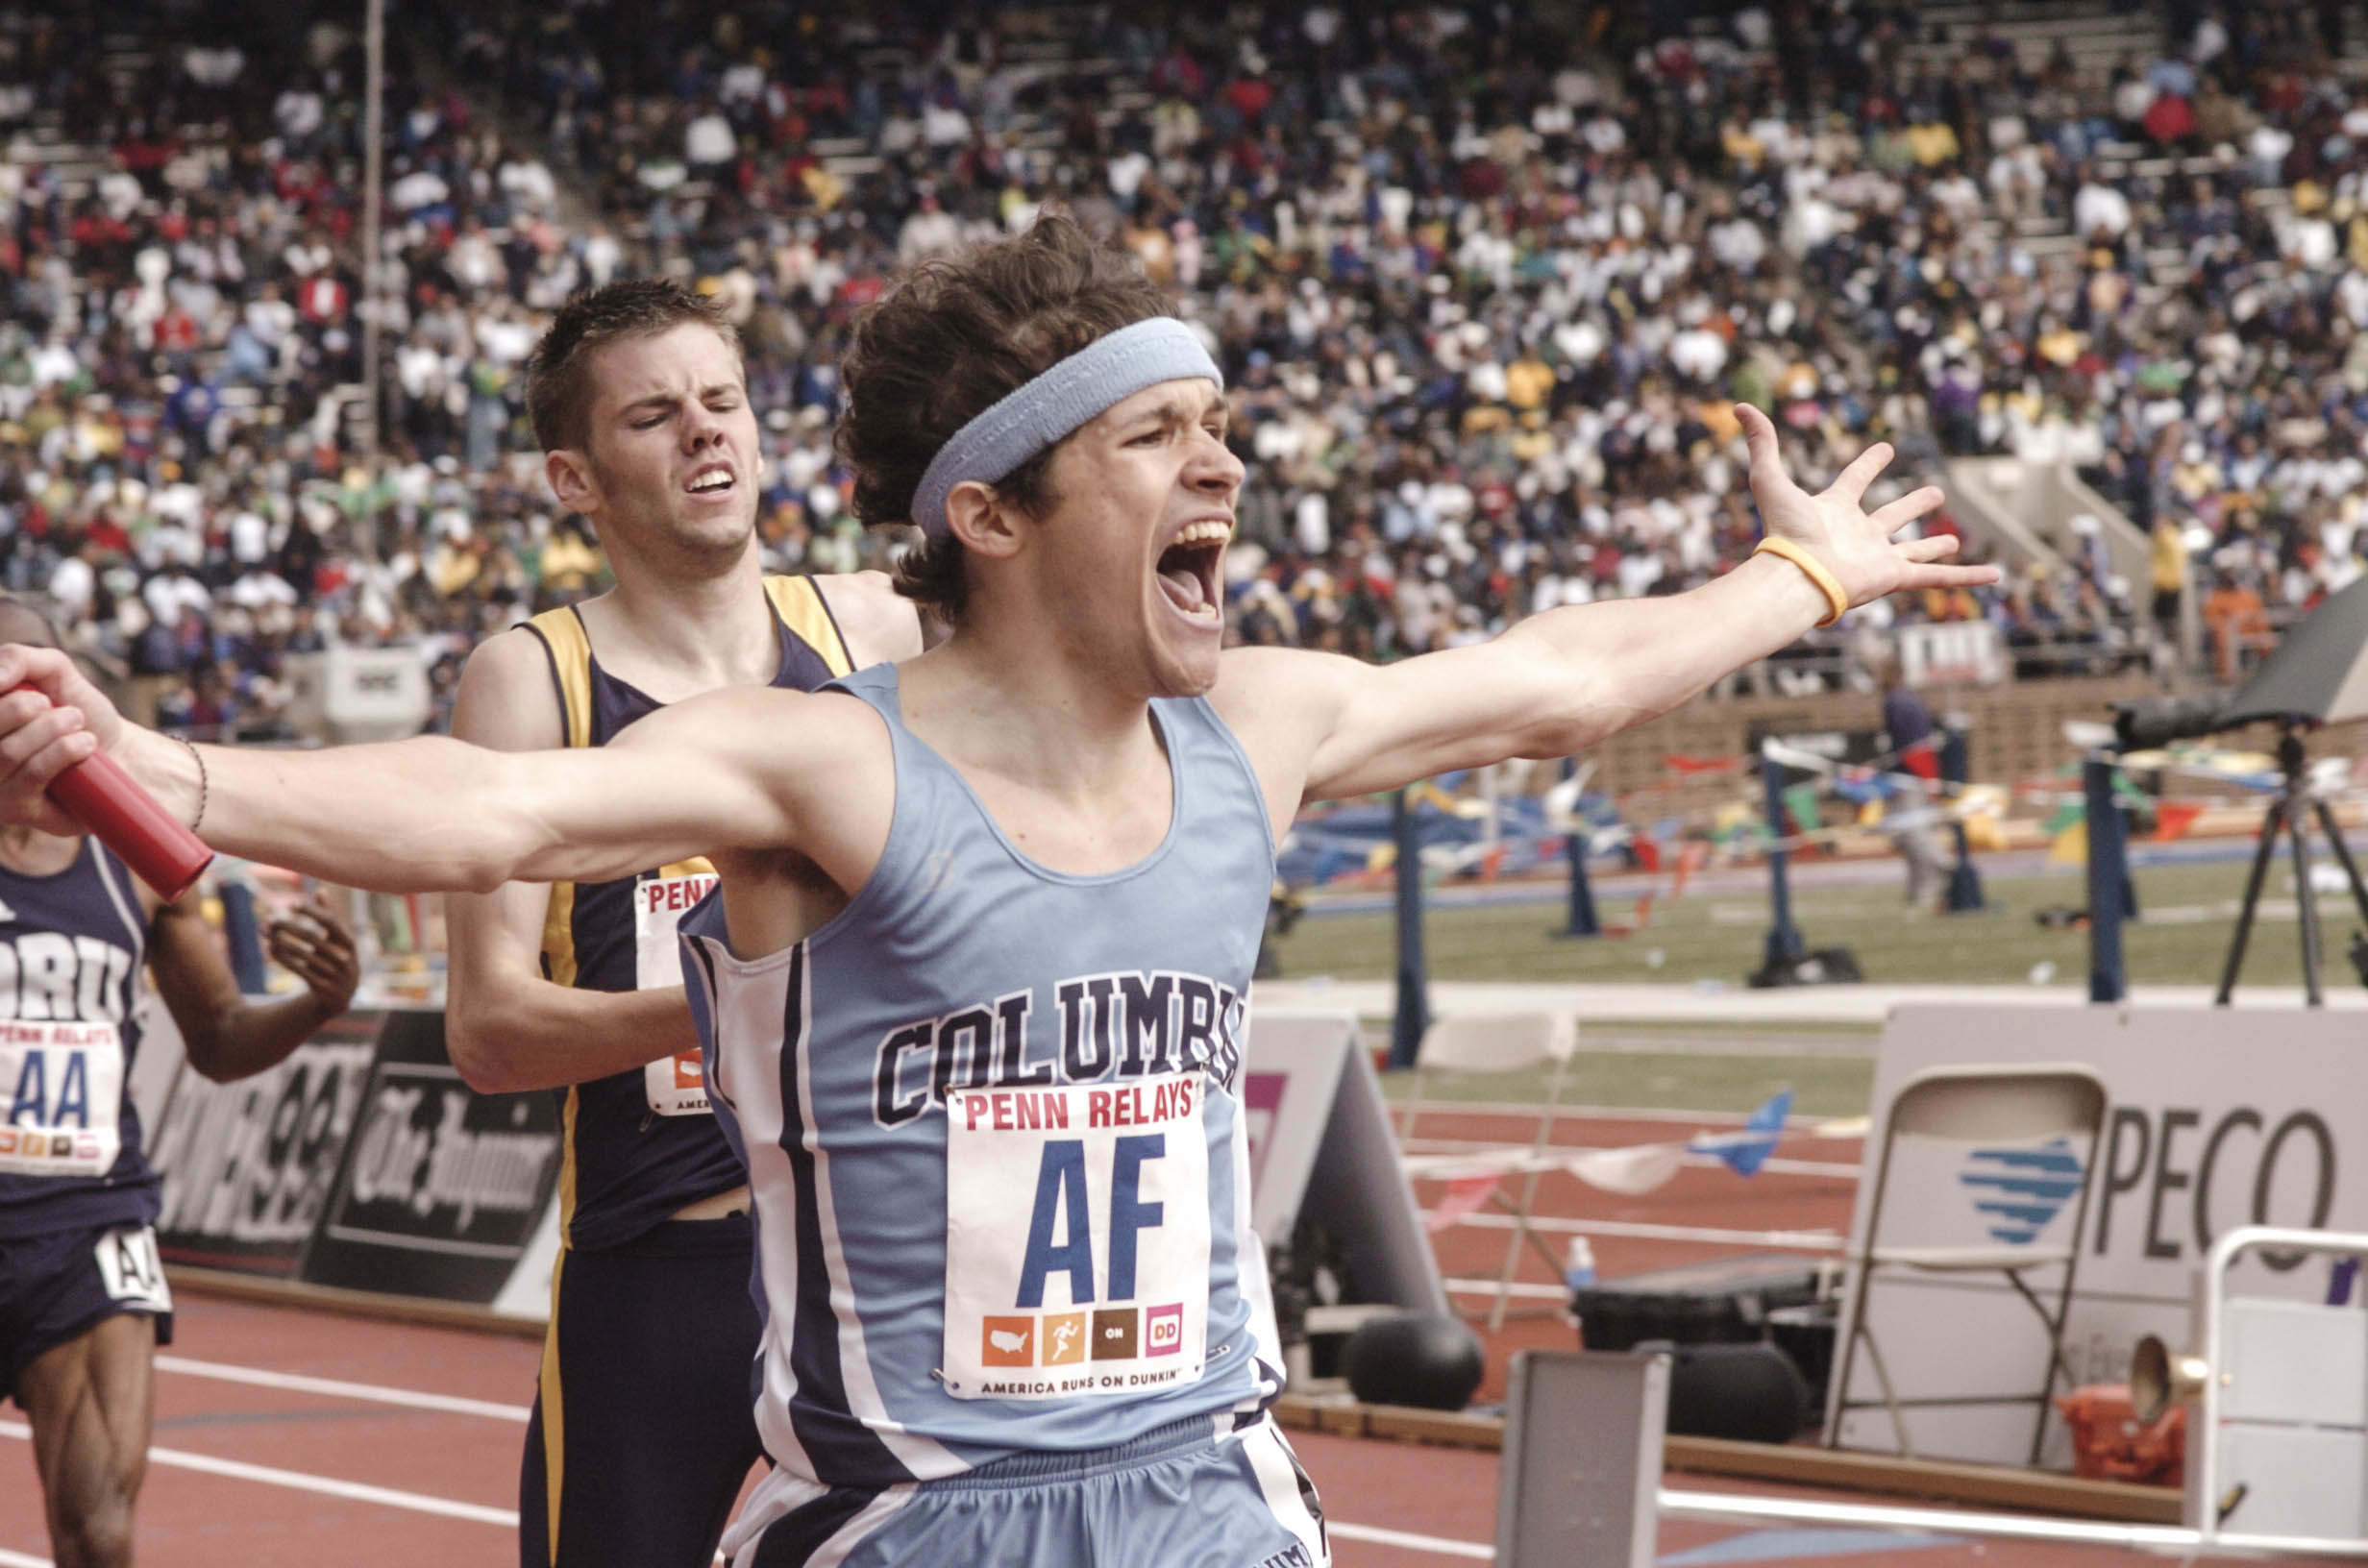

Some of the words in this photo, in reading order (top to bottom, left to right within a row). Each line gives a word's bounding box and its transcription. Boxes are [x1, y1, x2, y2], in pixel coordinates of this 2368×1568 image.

[9, 1050, 88, 1129] AA
[966, 1093, 1069, 1132] PENN
[1088, 1079, 1194, 1128] RELAYS
[1015, 1132, 1166, 1308] AF
[2093, 1108, 2336, 1271] PECO
[1105, 1327, 1123, 1339] ON
[1154, 1323, 1176, 1340] DD
[981, 1382, 1055, 1394] AMERICA
[1062, 1377, 1094, 1391] RUNS
[1101, 1375, 1123, 1388] ON
